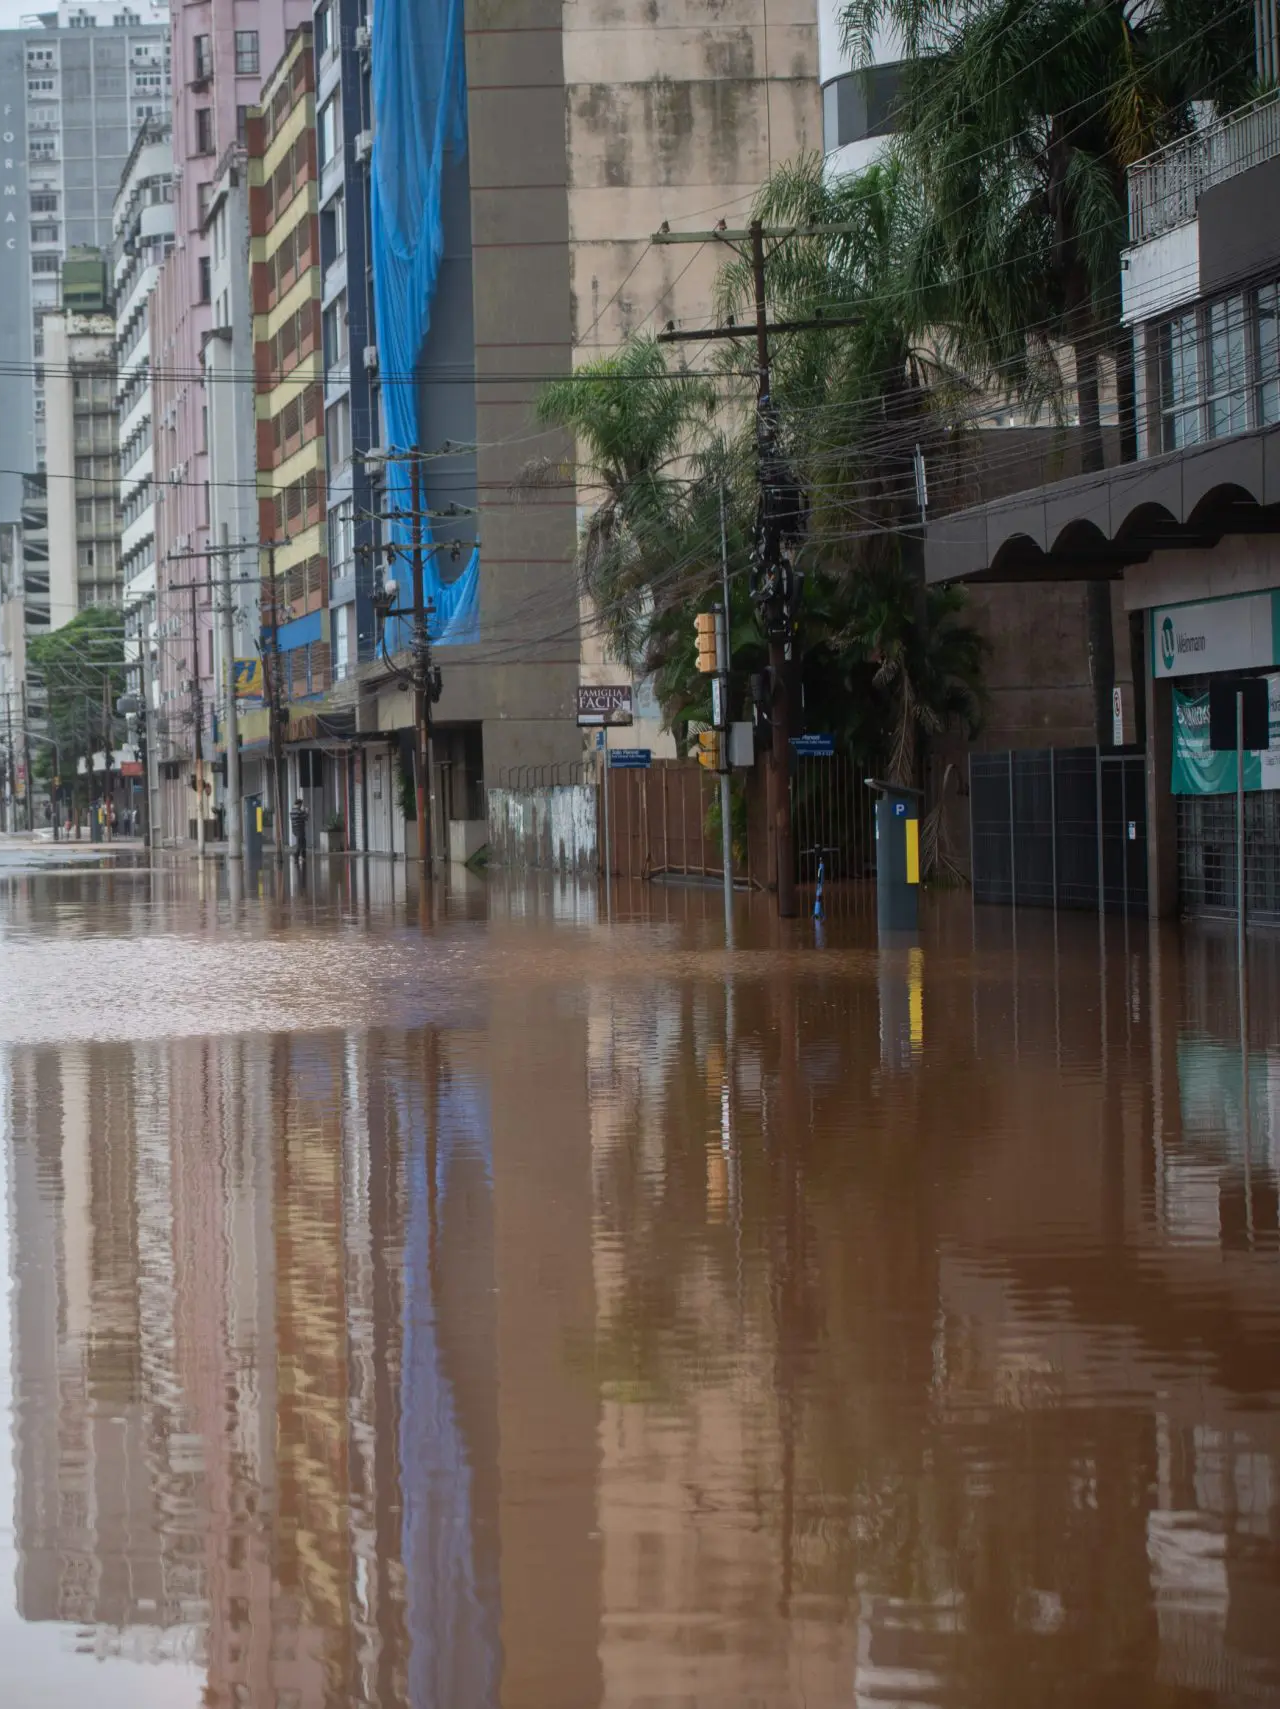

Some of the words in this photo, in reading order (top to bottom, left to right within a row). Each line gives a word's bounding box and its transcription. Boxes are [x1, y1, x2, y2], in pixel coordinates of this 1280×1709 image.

[3, 103, 16, 249] FORMAC
[578, 689, 623, 697] FAMIGLIA
[896, 804, 905, 815] P
